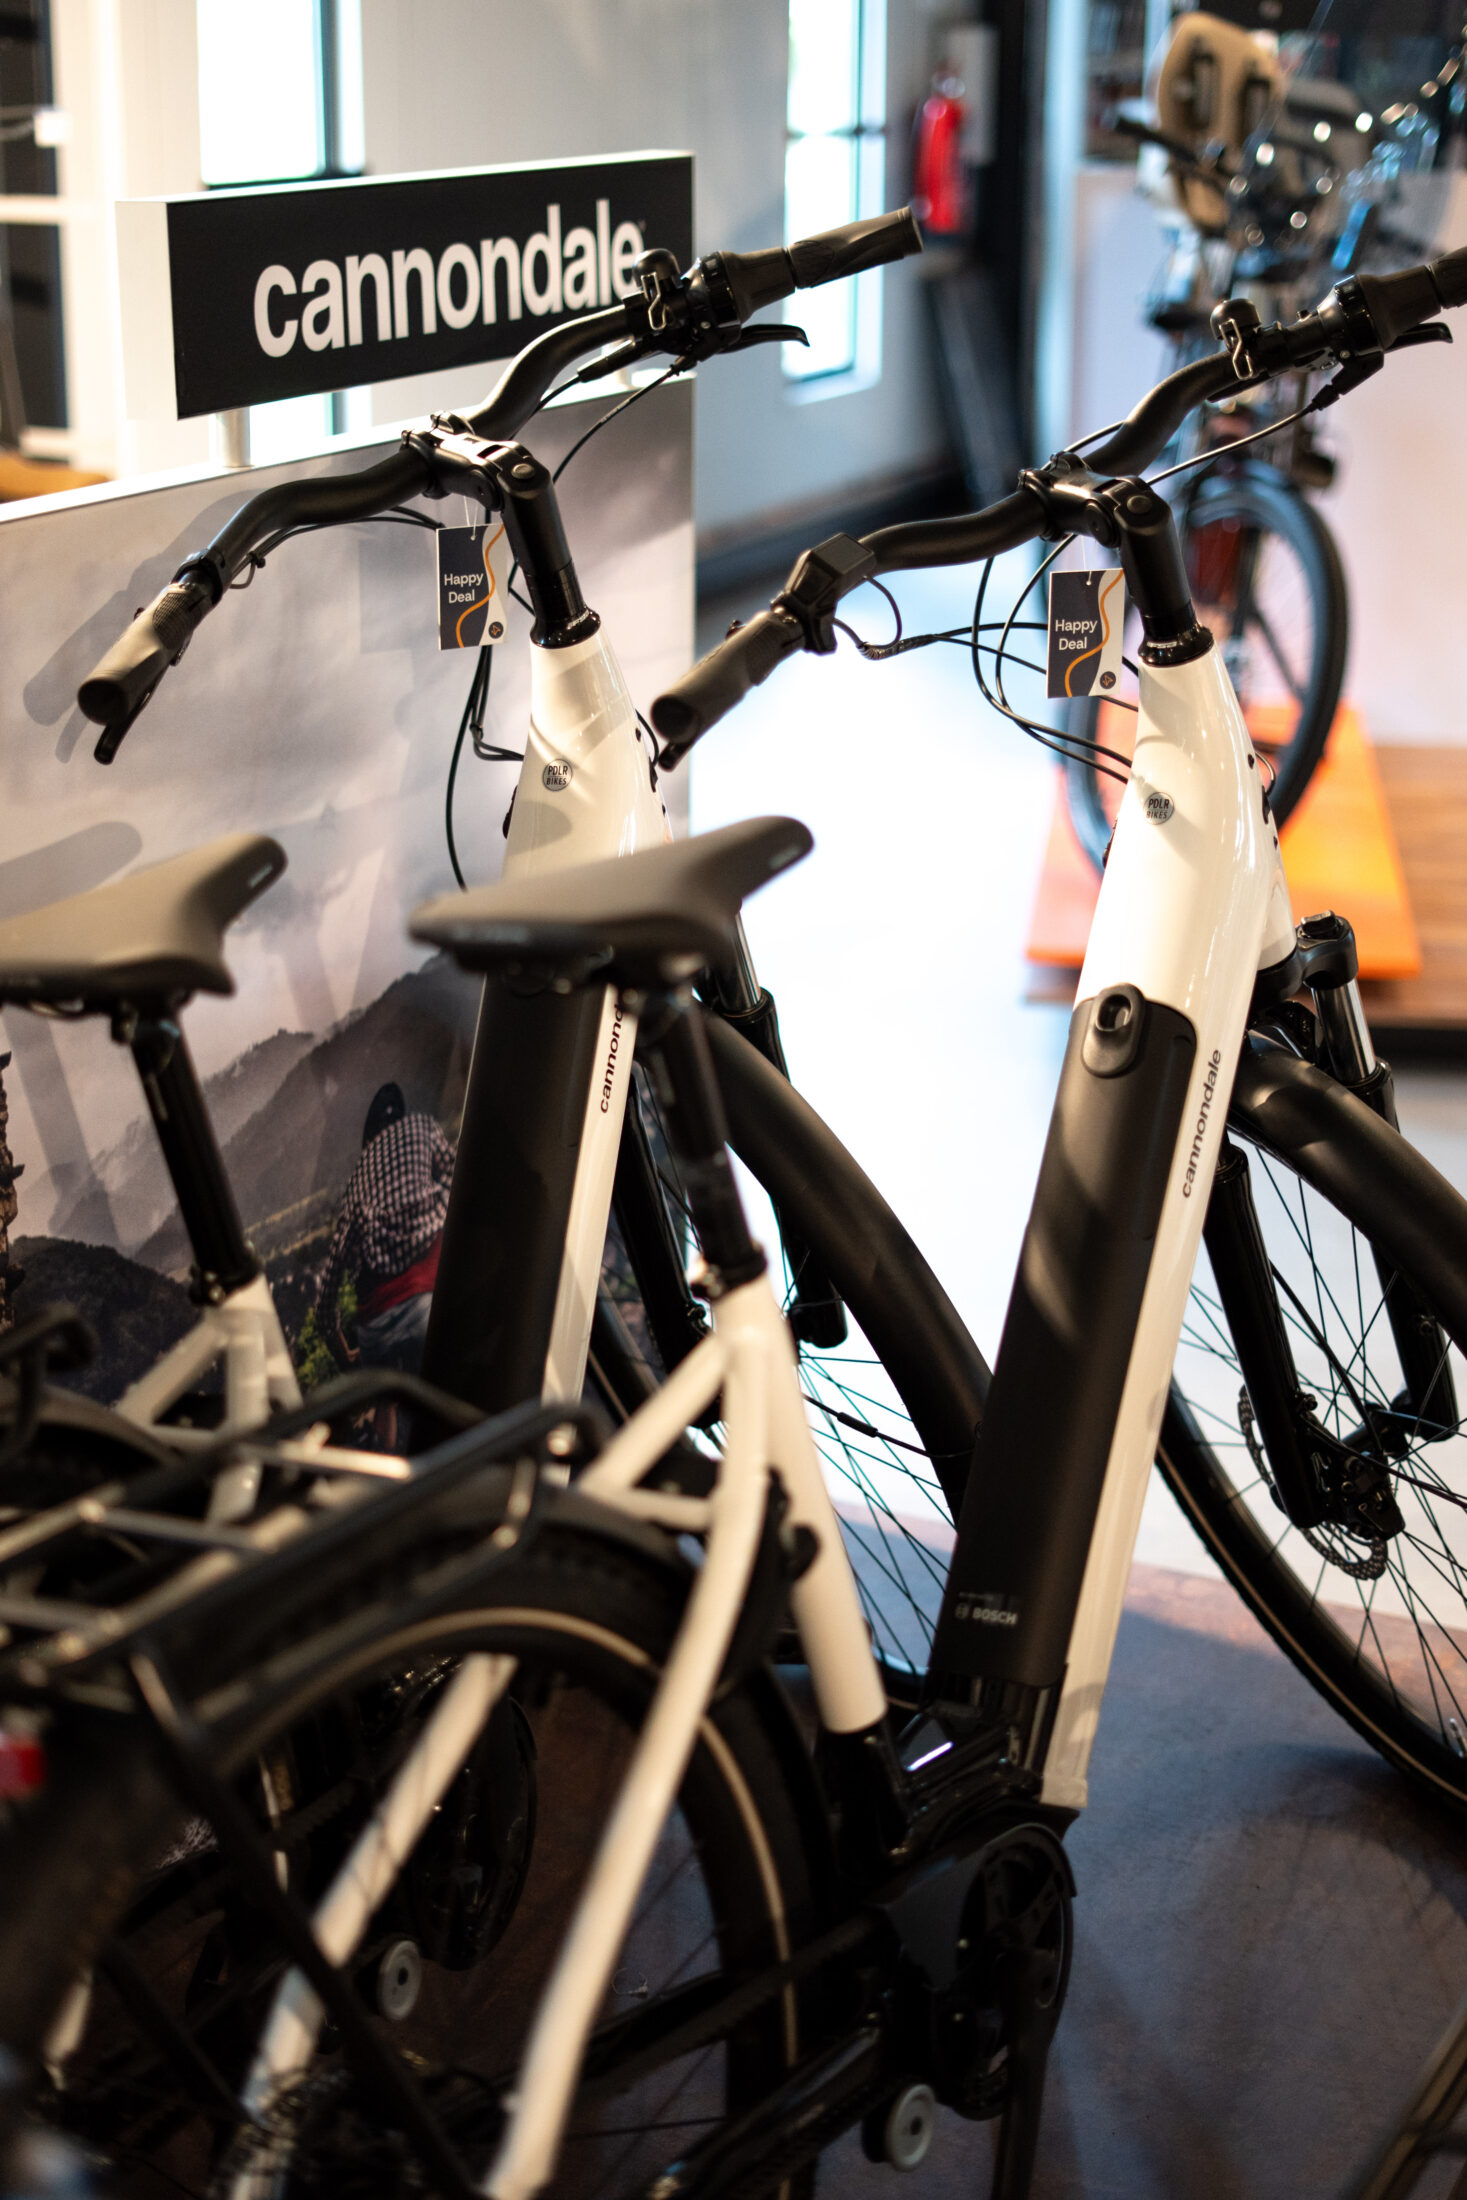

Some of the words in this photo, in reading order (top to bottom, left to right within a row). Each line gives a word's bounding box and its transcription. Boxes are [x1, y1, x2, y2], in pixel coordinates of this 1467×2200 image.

[254, 198, 644, 358] cannondale
[444, 573, 484, 588] Happy
[448, 589, 476, 604] Deal
[1055, 620, 1098, 634] Happy
[1058, 637, 1088, 651] Deal
[547, 765, 569, 776] PDLR
[546, 777, 568, 786] BIKES
[1147, 798, 1171, 809] PDLR
[1145, 810, 1168, 820] BIKES
[1182, 1049, 1222, 1199] cannondale
[971, 1607, 1018, 1625] BOSCH
